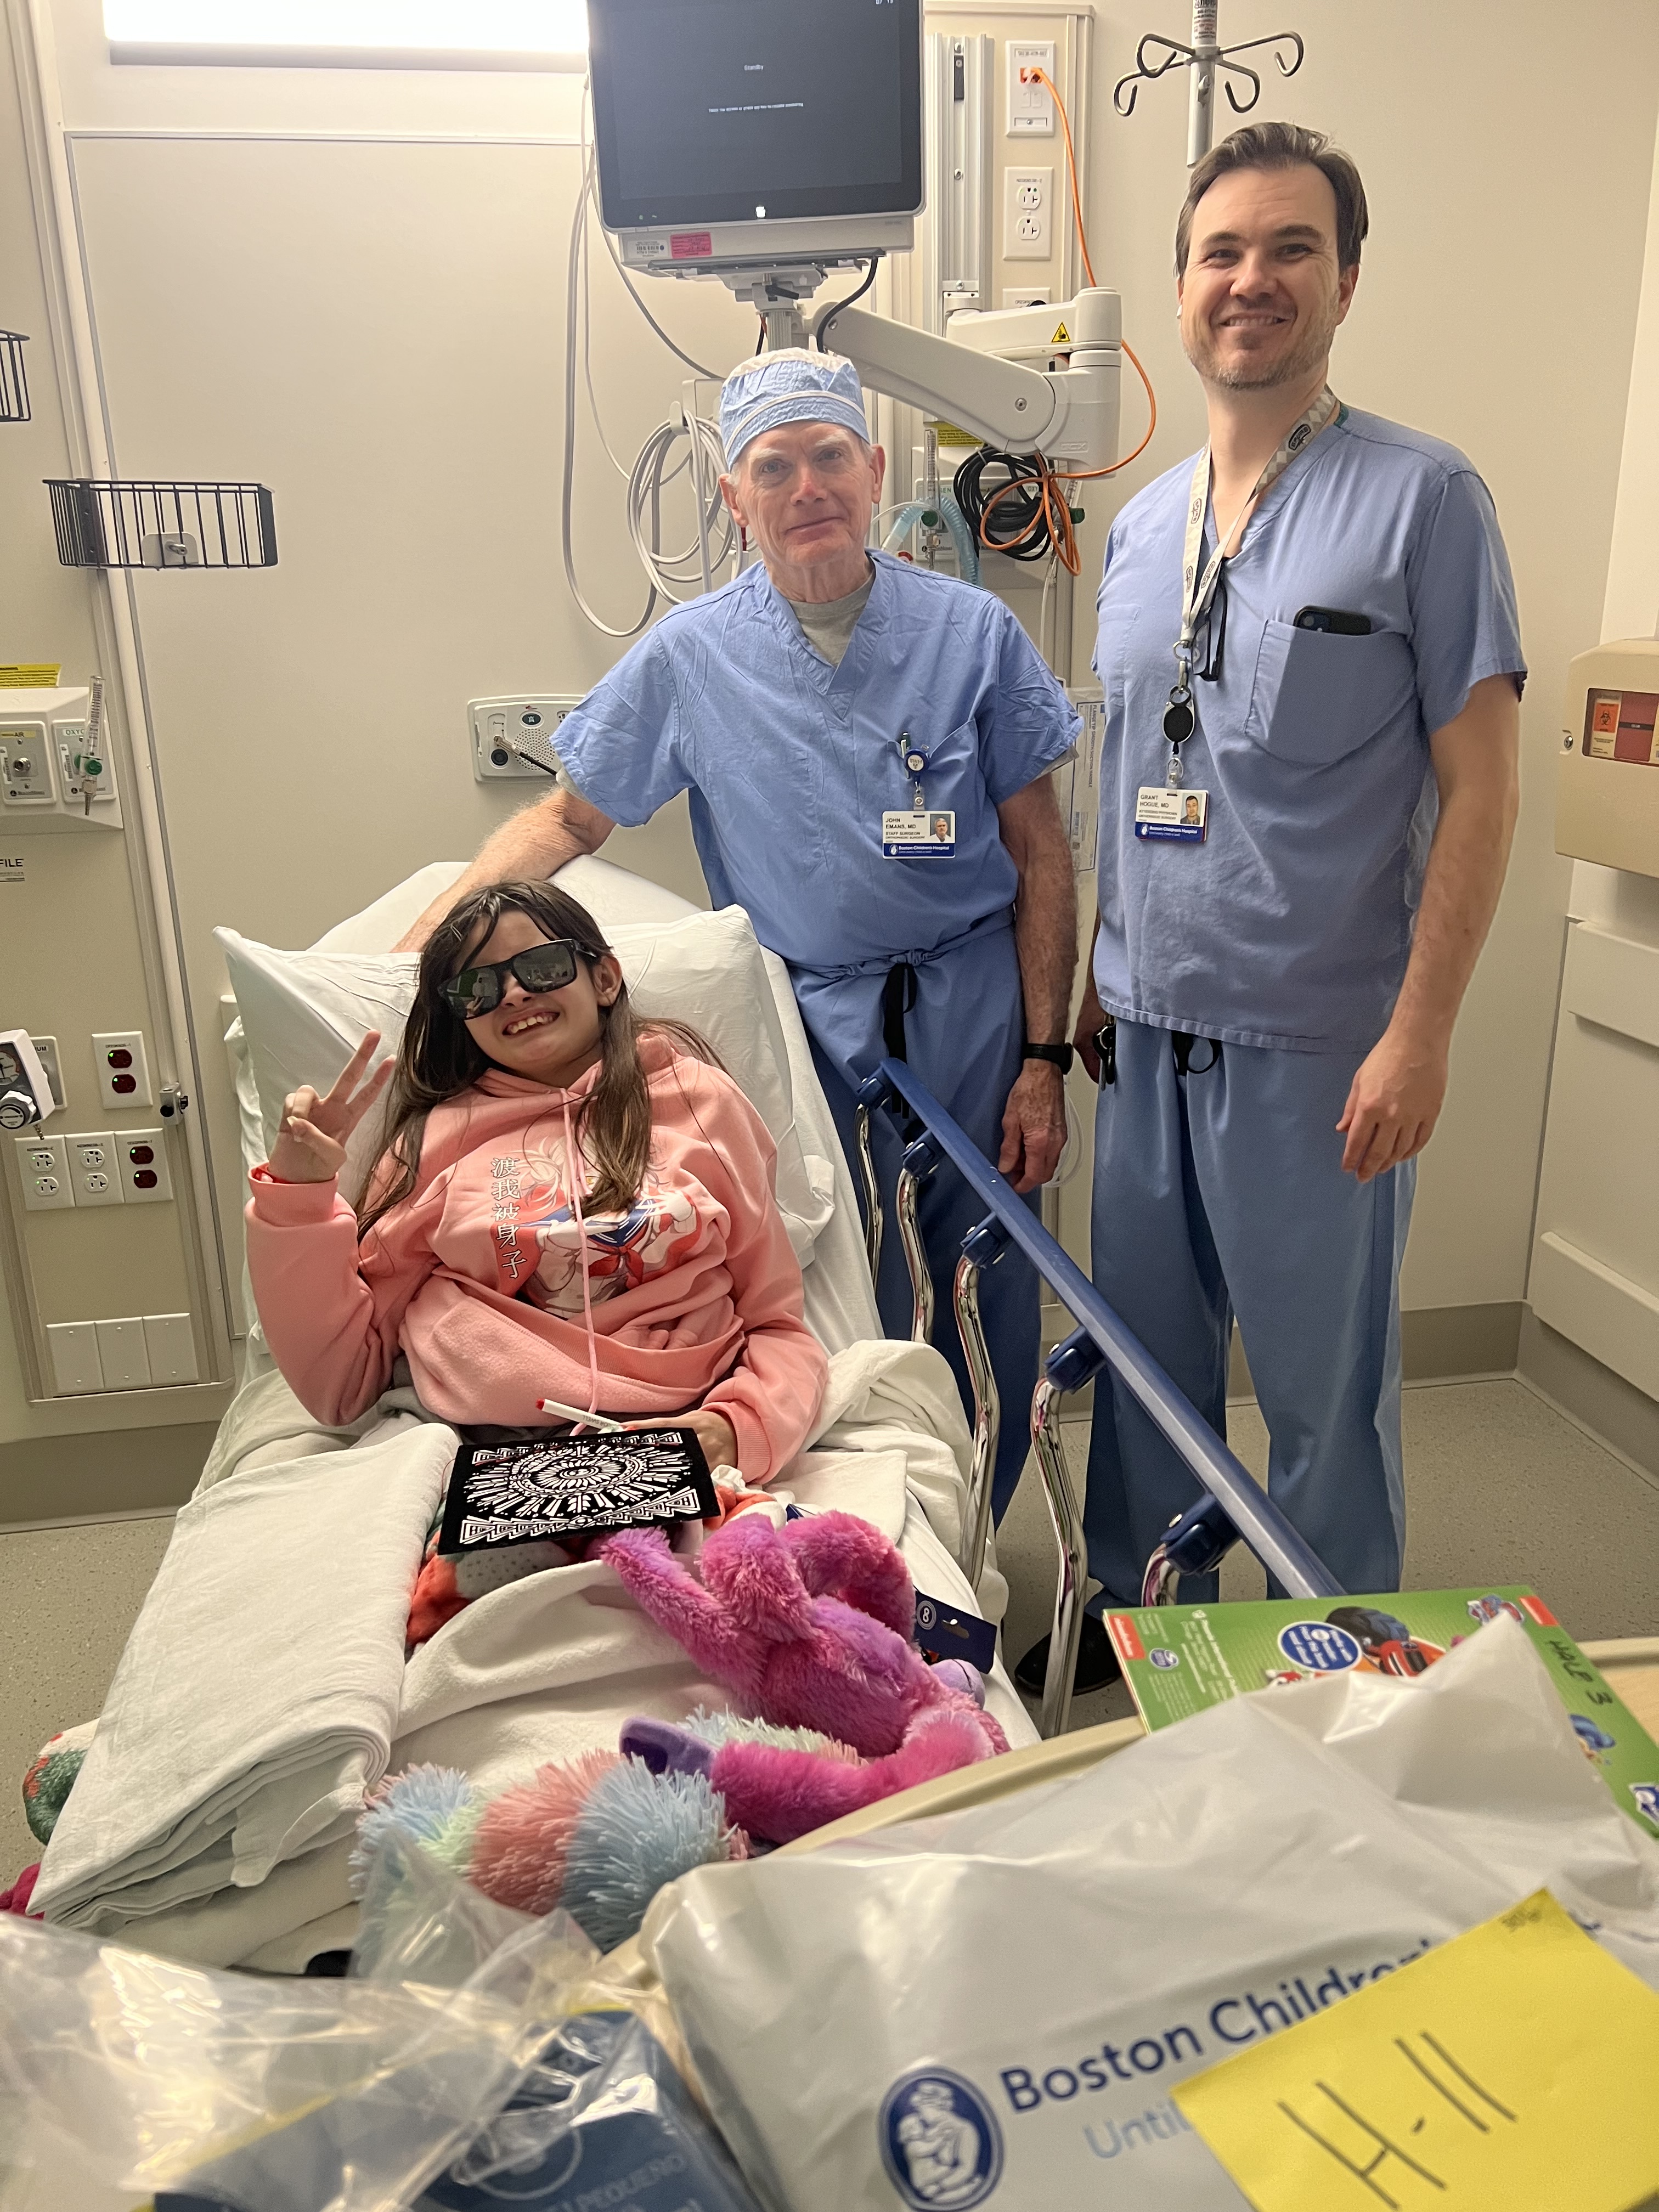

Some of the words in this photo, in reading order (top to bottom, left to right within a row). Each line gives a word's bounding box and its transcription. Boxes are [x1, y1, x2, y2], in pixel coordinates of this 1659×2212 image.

[491, 1151, 528, 1279] 渡我被身子
[582, 1414, 600, 1425] SWELL
[1585, 1689, 1613, 1706] 3
[999, 2023, 1204, 2114] Boston
[1083, 2097, 1192, 2159] Until
